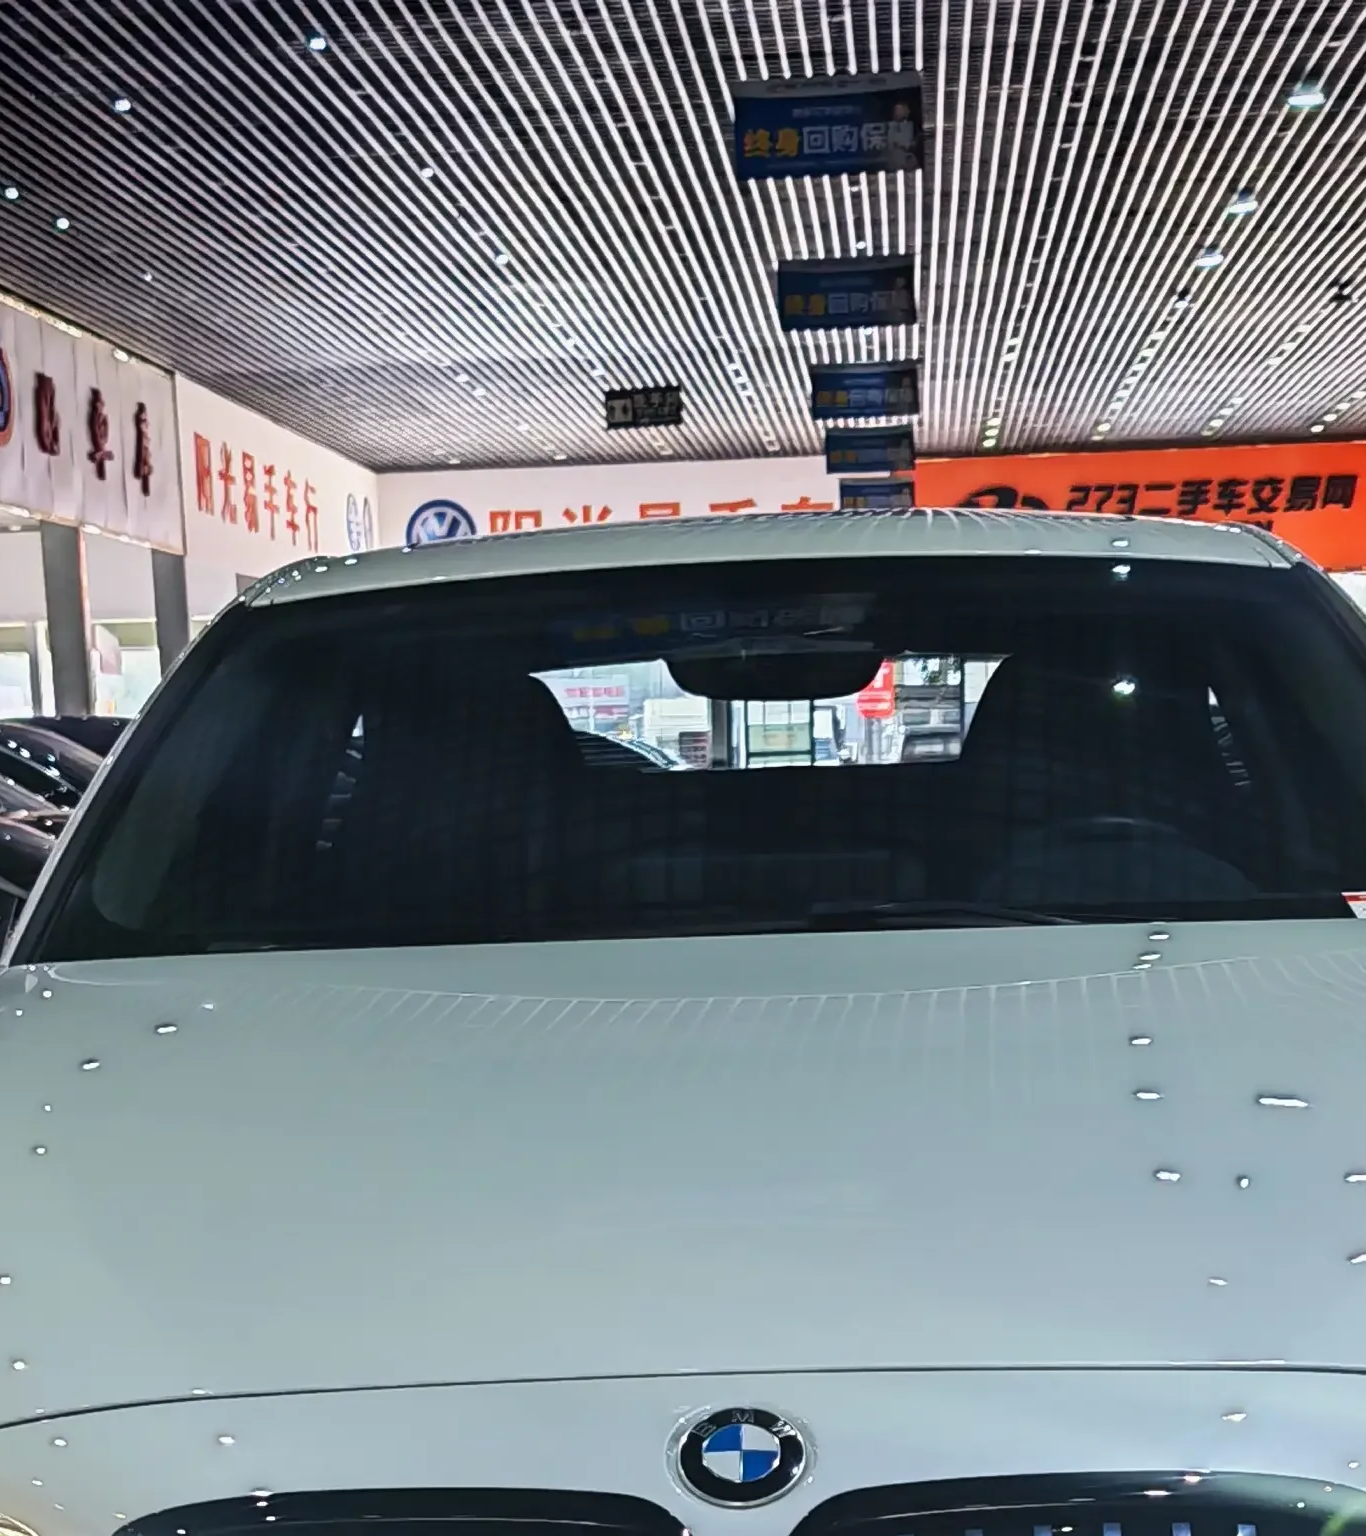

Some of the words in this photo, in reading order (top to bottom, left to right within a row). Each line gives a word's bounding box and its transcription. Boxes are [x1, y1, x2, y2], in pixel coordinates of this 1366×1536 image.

[743, 122, 916, 158] 终身回购保
[1066, 475, 1358, 516] 273二手车交易网
